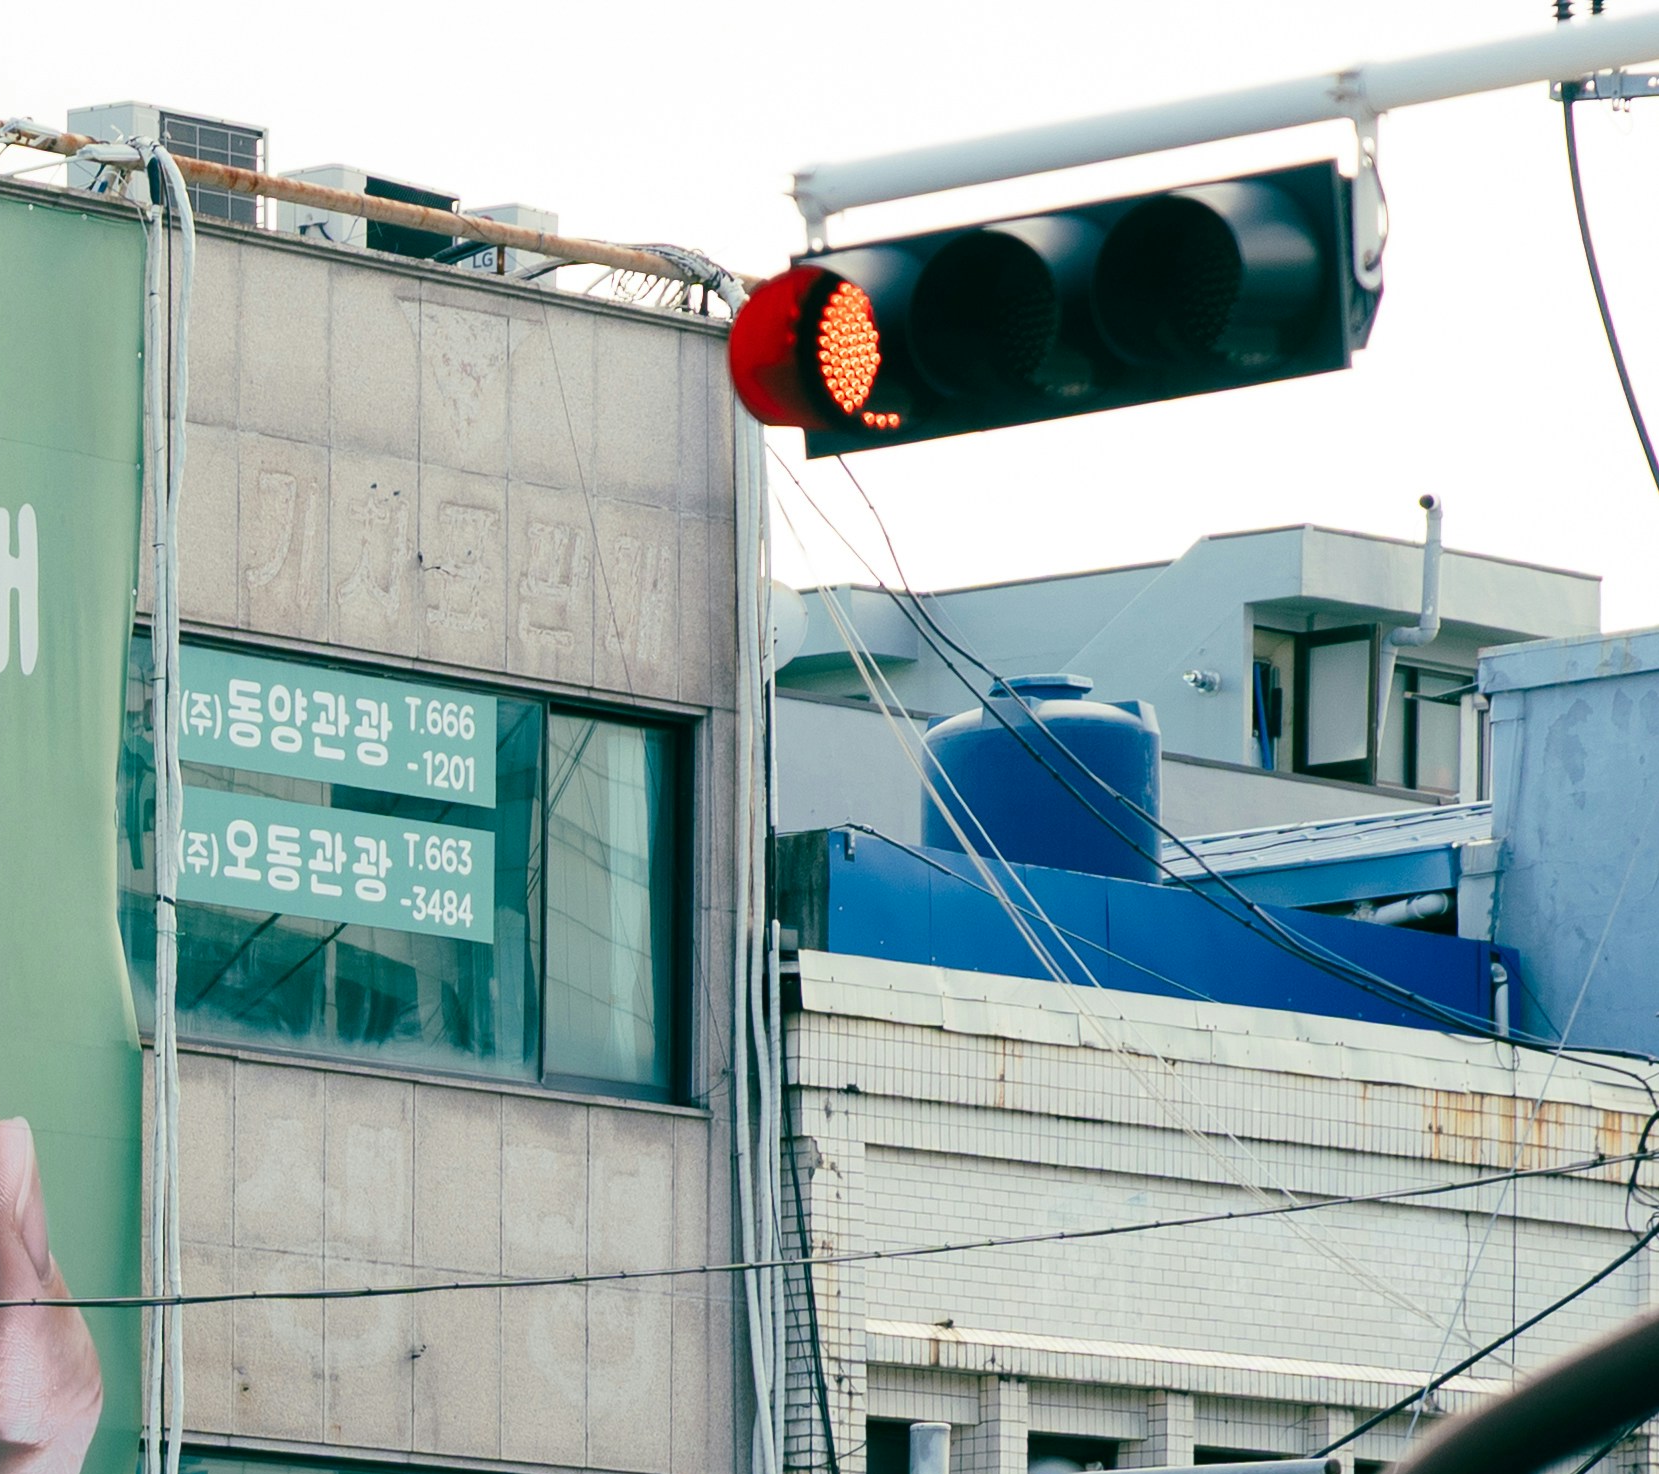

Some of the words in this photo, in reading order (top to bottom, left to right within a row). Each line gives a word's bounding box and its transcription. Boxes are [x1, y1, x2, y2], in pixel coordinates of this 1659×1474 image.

[472, 252, 494, 269] LG
[180, 676, 394, 768] (주)동양관광
[405, 696, 475, 741] T.666
[407, 749, 475, 794] -1201
[176, 818, 393, 902] (주)오동관광
[403, 832, 473, 876] T.663
[400, 886, 474, 929] -3484
